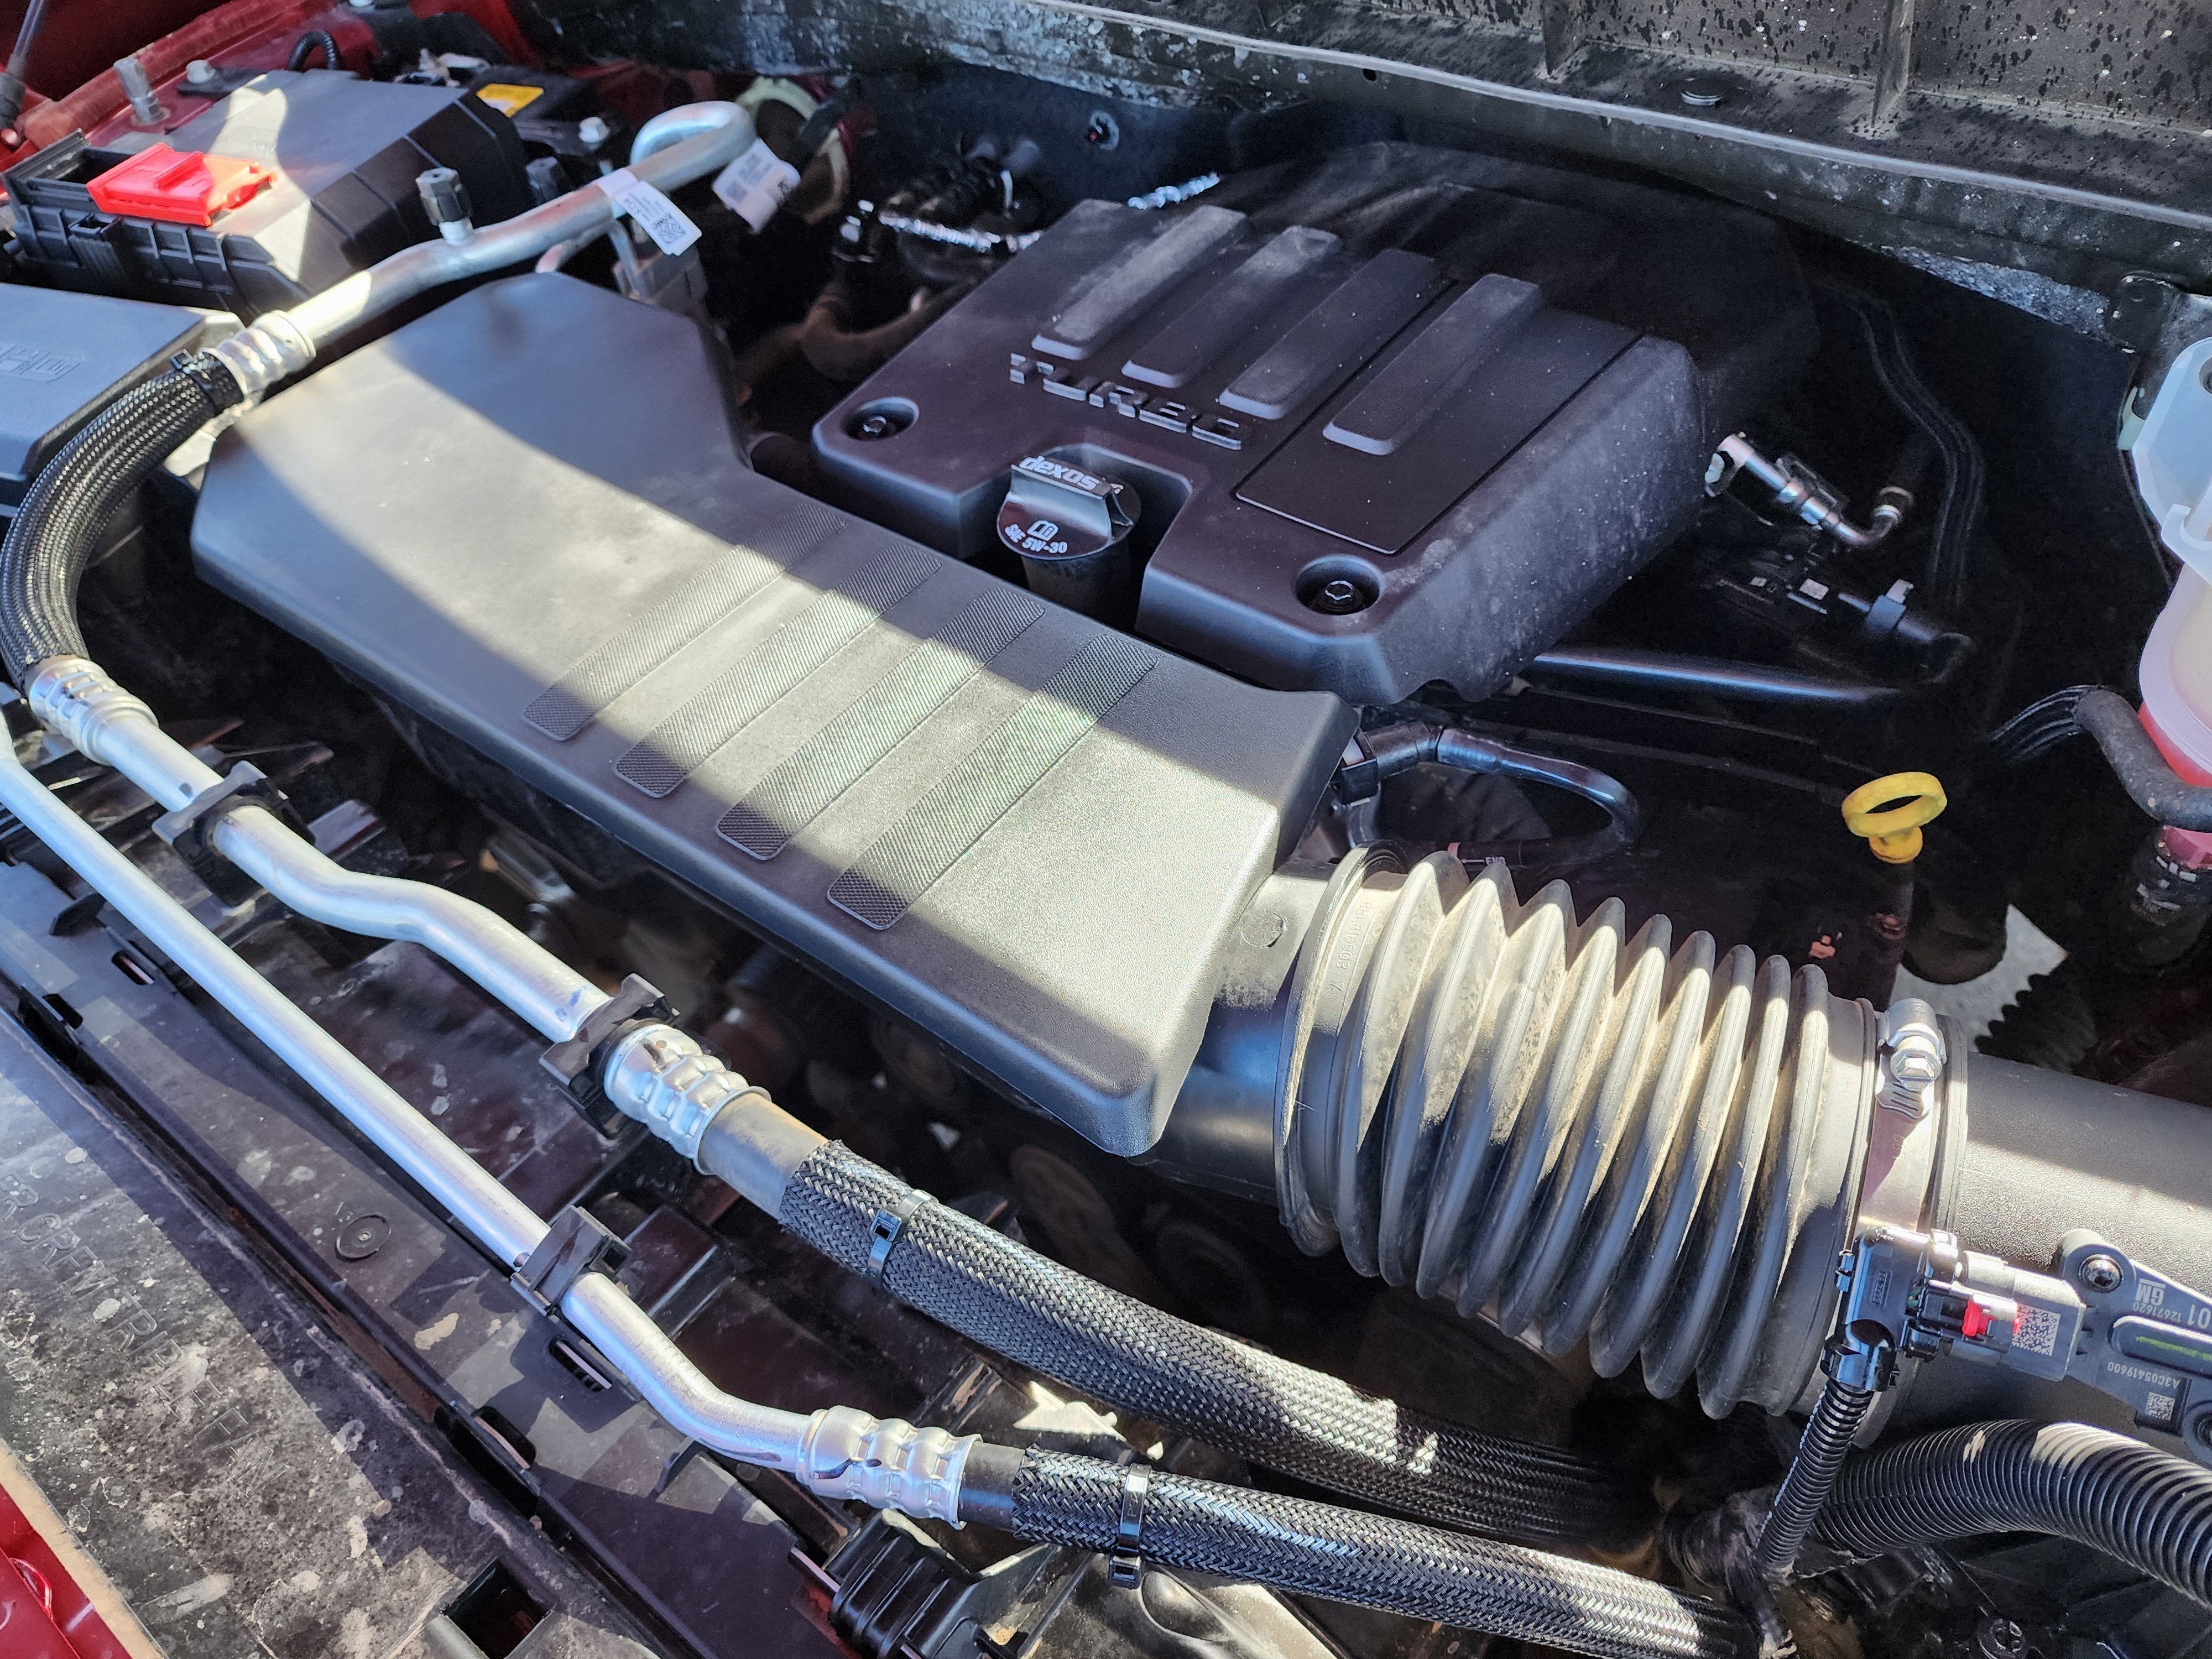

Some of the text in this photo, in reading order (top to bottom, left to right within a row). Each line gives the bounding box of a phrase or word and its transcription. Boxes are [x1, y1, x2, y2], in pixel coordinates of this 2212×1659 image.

[1019, 456, 1100, 491] dexos
[1004, 524, 1068, 554] SAE 5W-30
[2135, 1281, 2165, 1306] GM
[2133, 1302, 2181, 1322] 12671620
[2107, 1361, 2181, 1389] A3C05419600
[93, 1288, 222, 1425] TRIPLE
[195, 1407, 289, 1497] FAN
